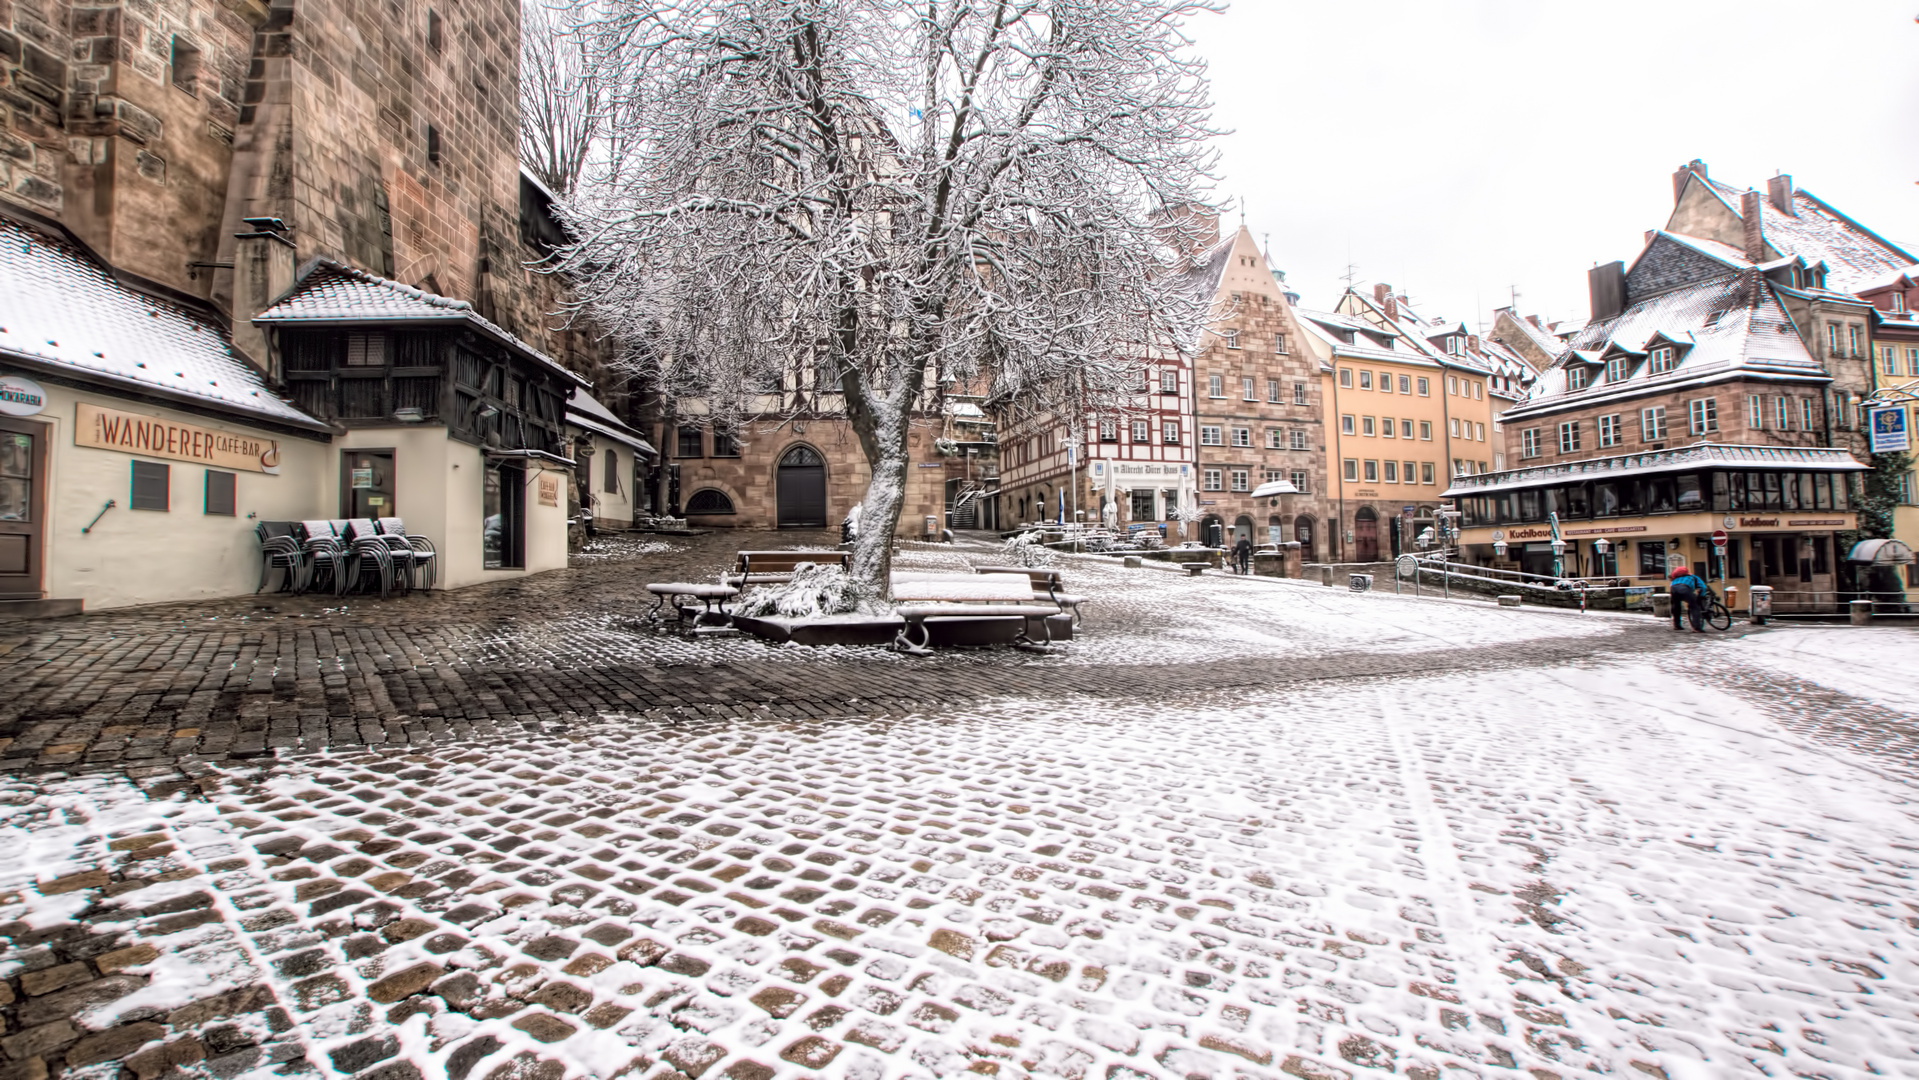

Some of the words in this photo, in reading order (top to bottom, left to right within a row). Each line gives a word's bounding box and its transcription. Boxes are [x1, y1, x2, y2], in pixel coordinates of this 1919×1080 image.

[102, 413, 214, 460] WANDERER
[1120, 464, 1143, 474] Albrecht
[1145, 464, 1161, 474] Dürer
[1163, 464, 1178, 475] Haus
